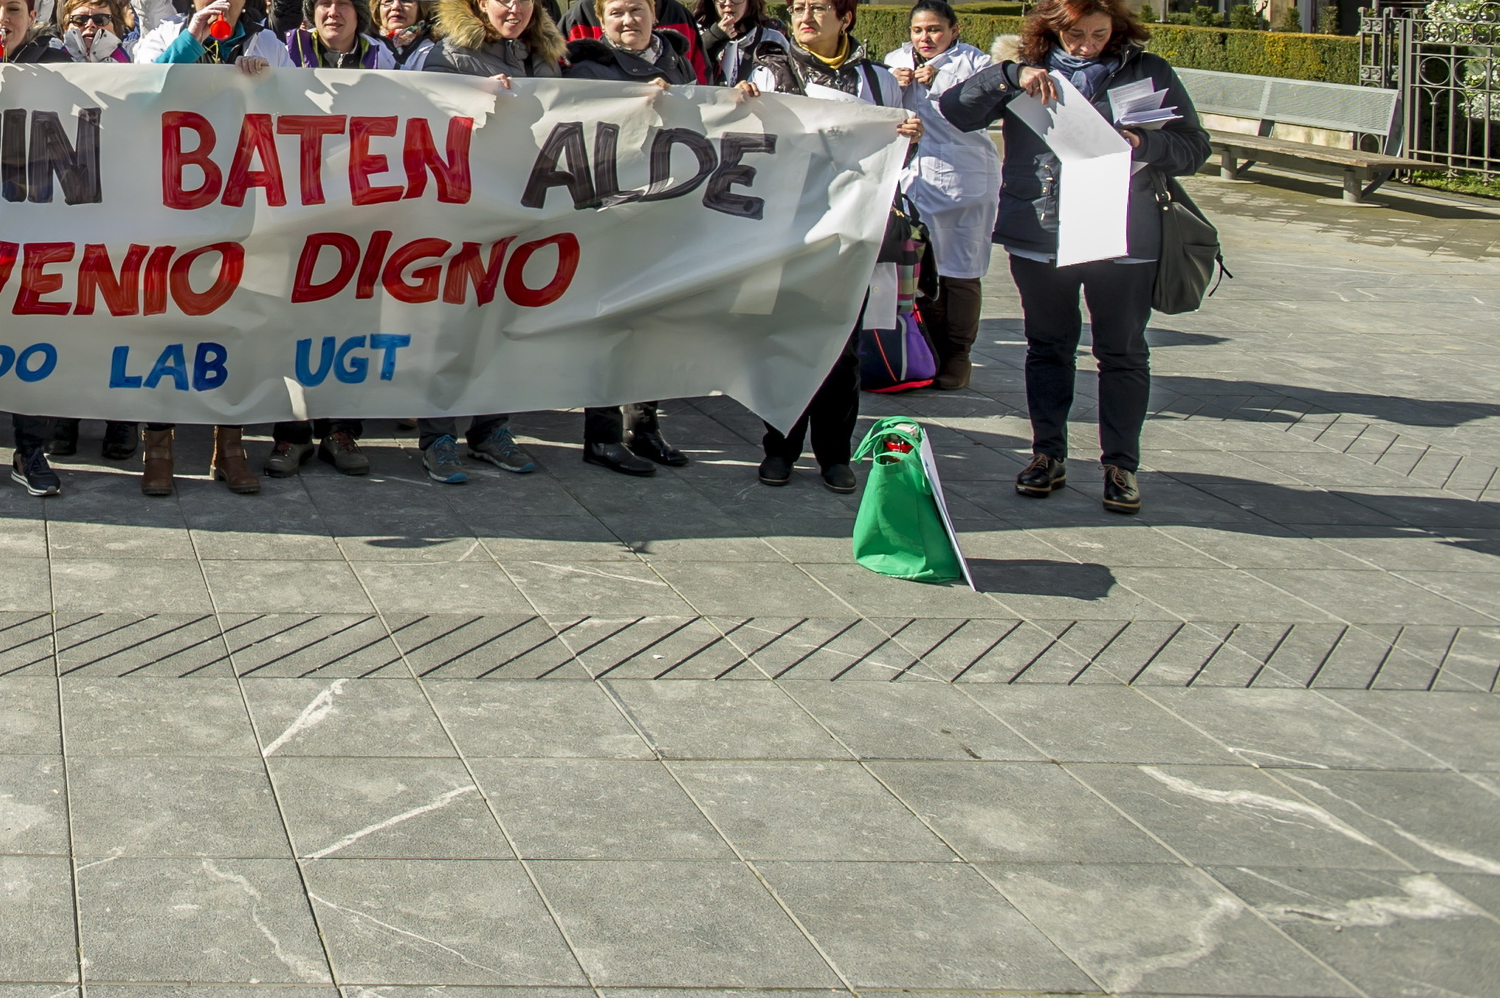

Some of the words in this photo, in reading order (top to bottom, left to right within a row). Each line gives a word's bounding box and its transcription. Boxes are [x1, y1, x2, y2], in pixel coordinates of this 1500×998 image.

[161, 111, 474, 210] BATEN
[521, 122, 777, 220] ALDE
[291, 231, 580, 307] DIGNO
[109, 343, 228, 391] LAB
[296, 334, 410, 387] UGT
